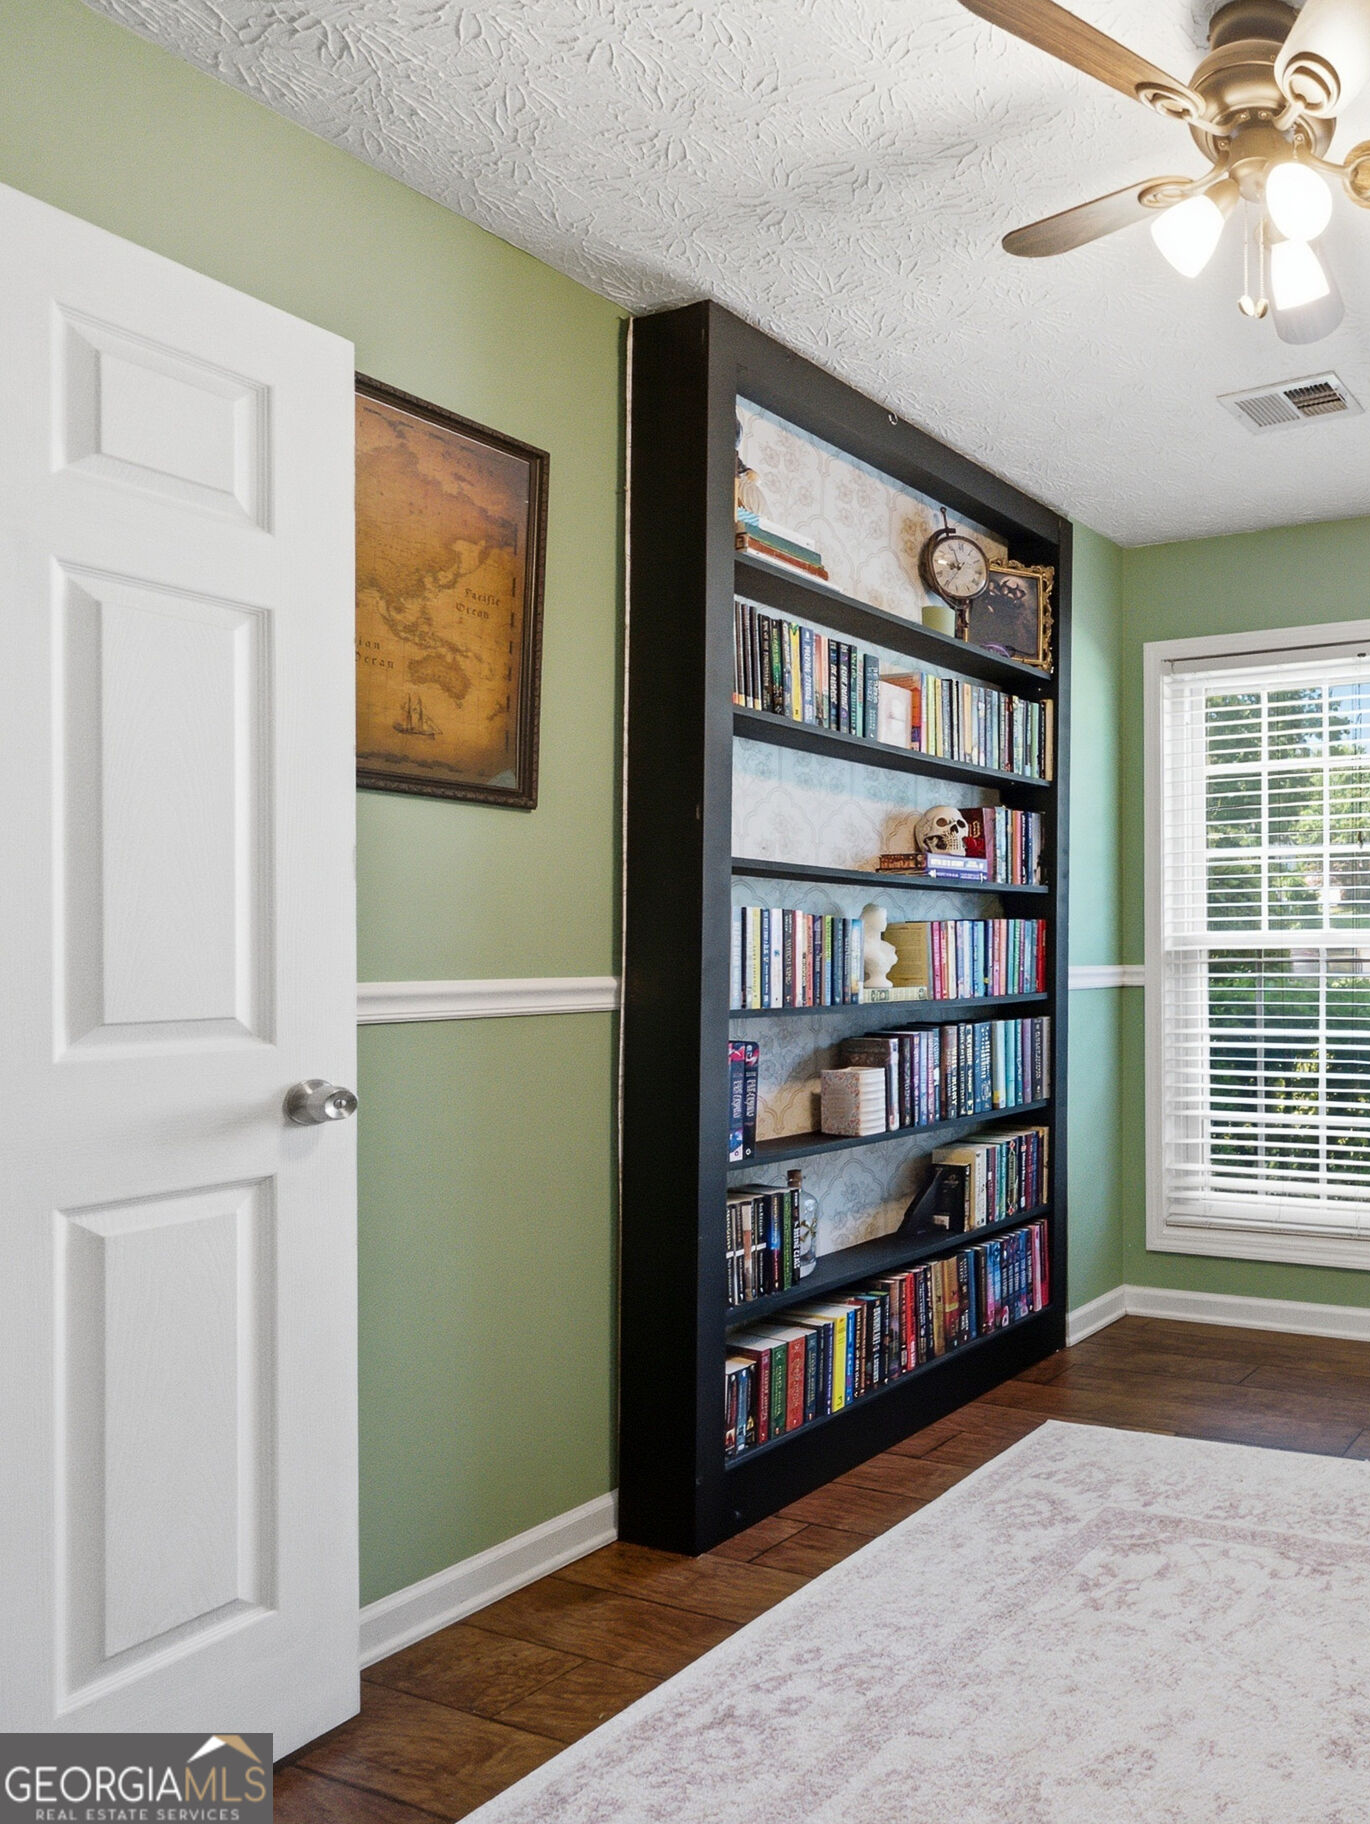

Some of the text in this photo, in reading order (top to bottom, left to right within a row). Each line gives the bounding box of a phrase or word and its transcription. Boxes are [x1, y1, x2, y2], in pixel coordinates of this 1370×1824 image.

[465, 588, 499, 606] Pacific
[456, 602, 489, 619] Ocean
[357, 637, 380, 650] ian
